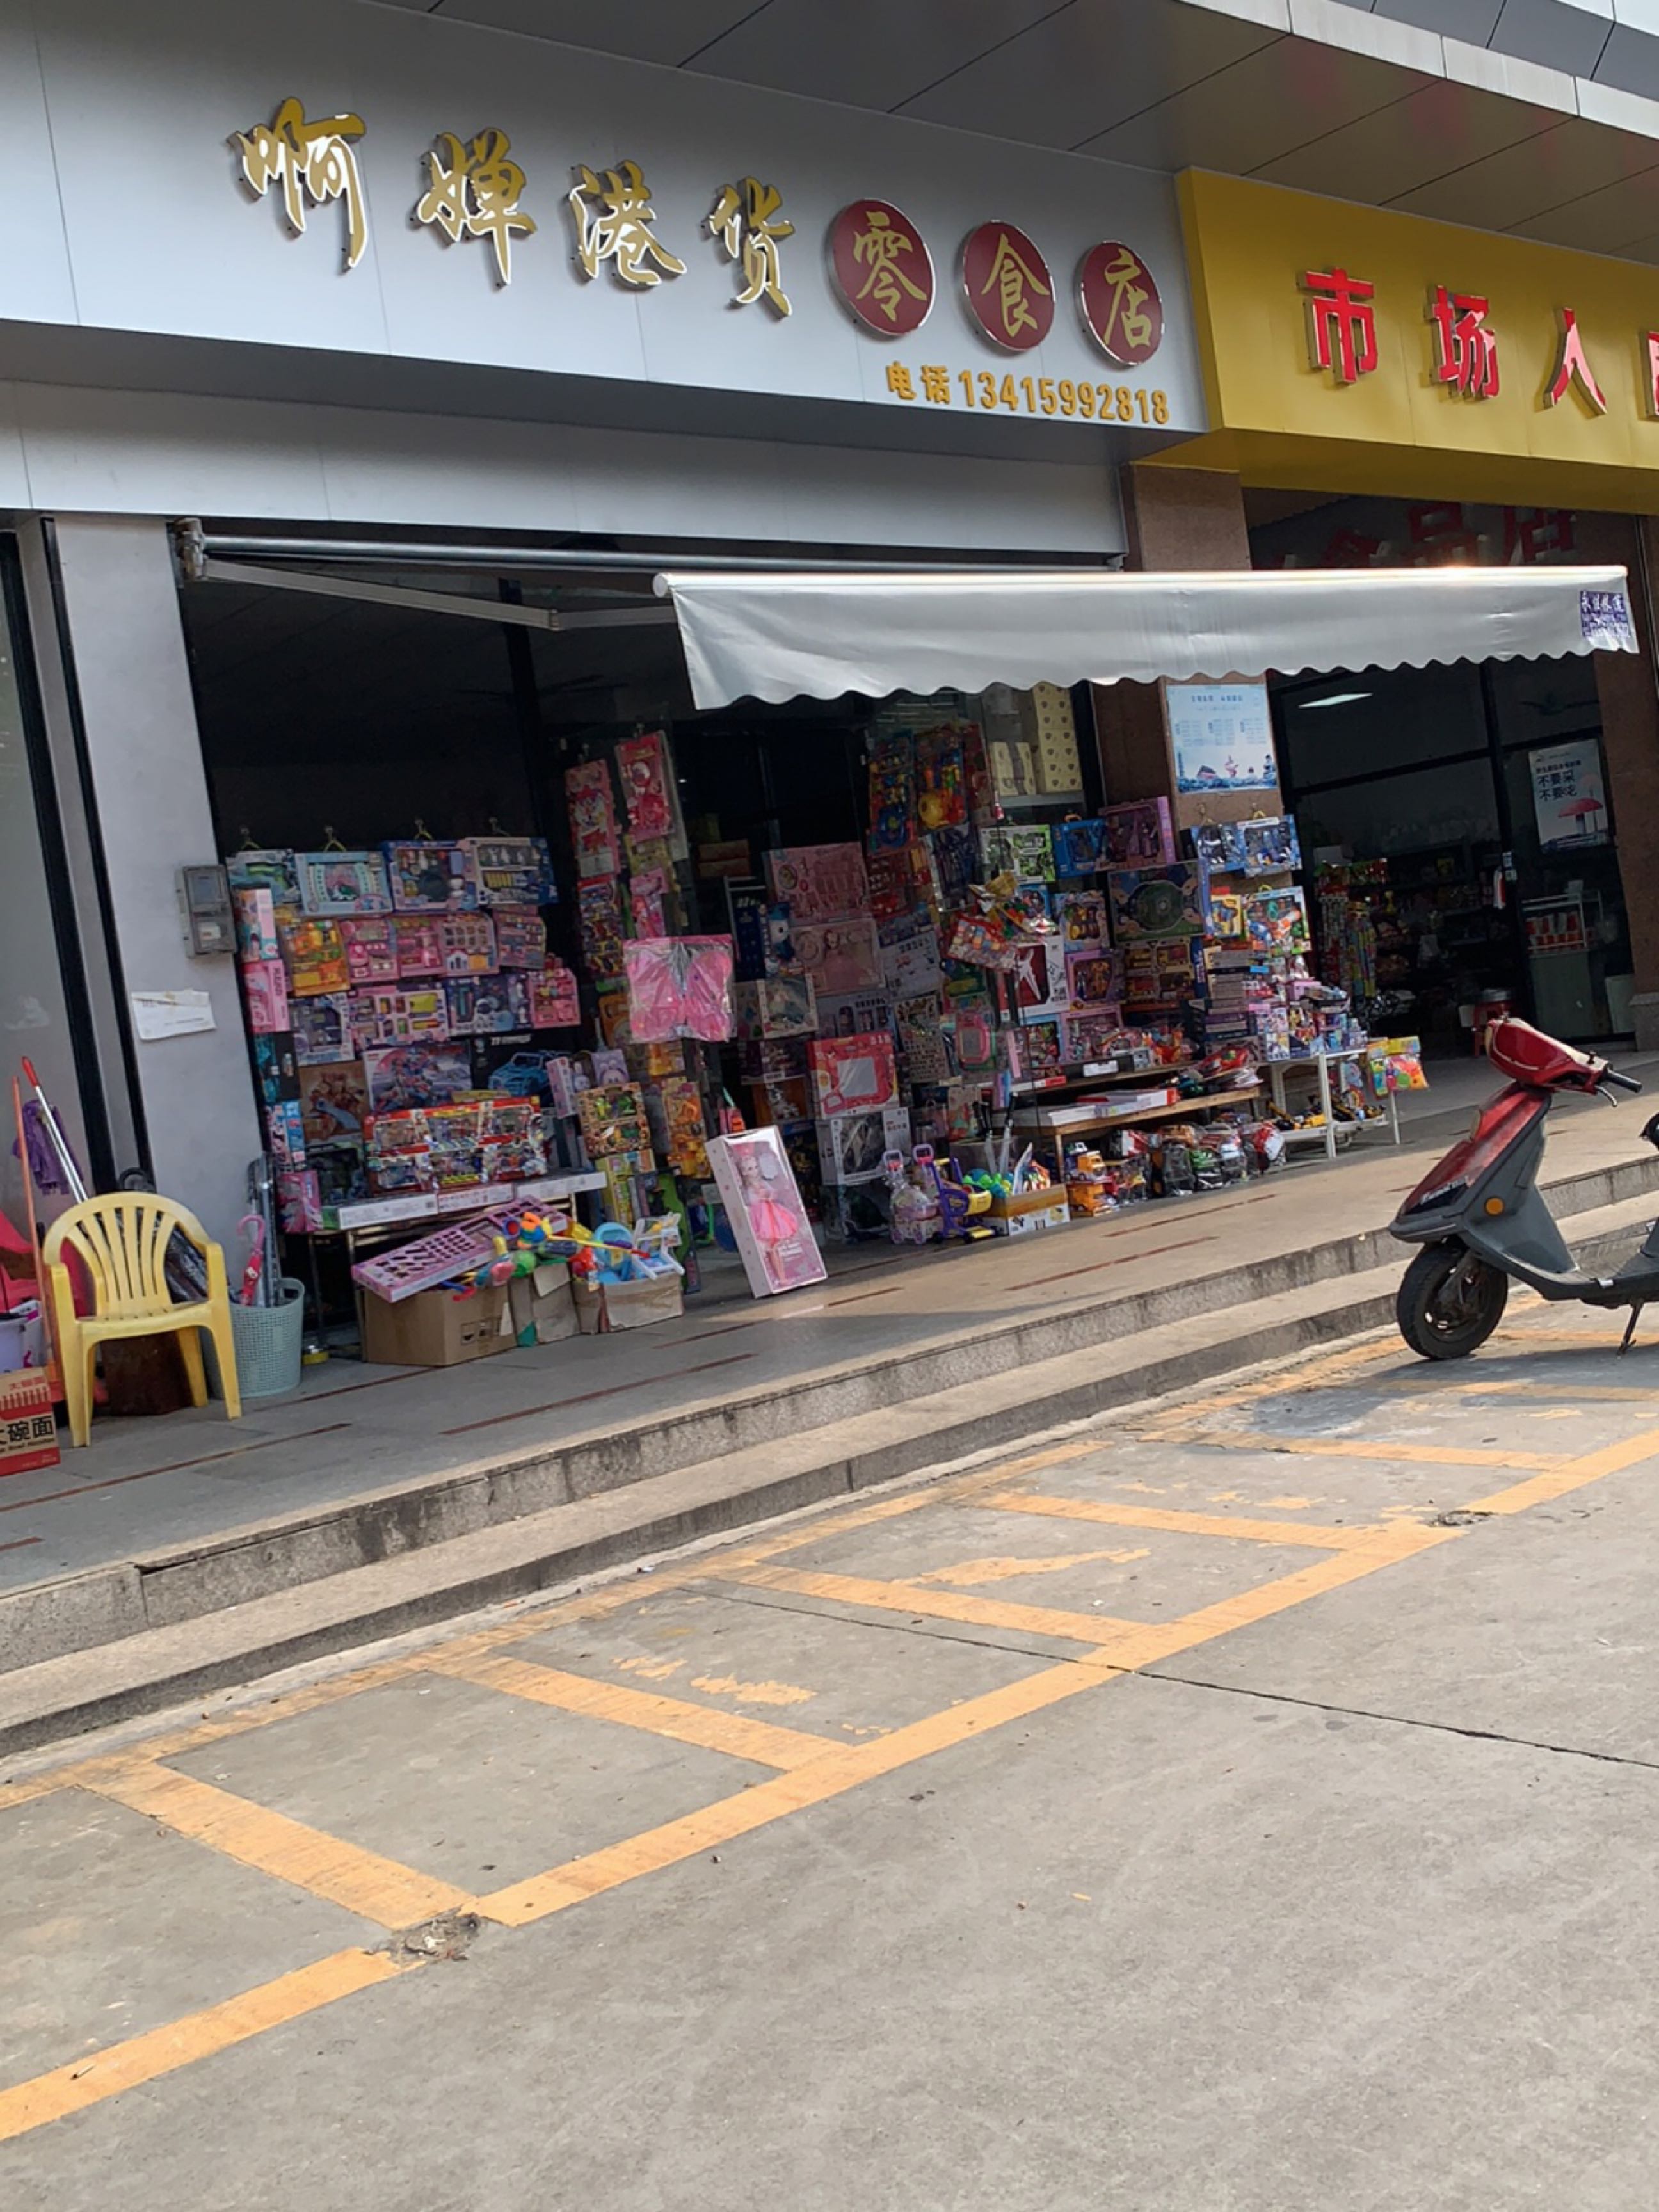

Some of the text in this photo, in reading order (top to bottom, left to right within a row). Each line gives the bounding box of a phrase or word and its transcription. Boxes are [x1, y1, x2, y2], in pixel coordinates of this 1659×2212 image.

[853, 211, 1151, 349] 零食店
[1297, 266, 1659, 420] 市场人
